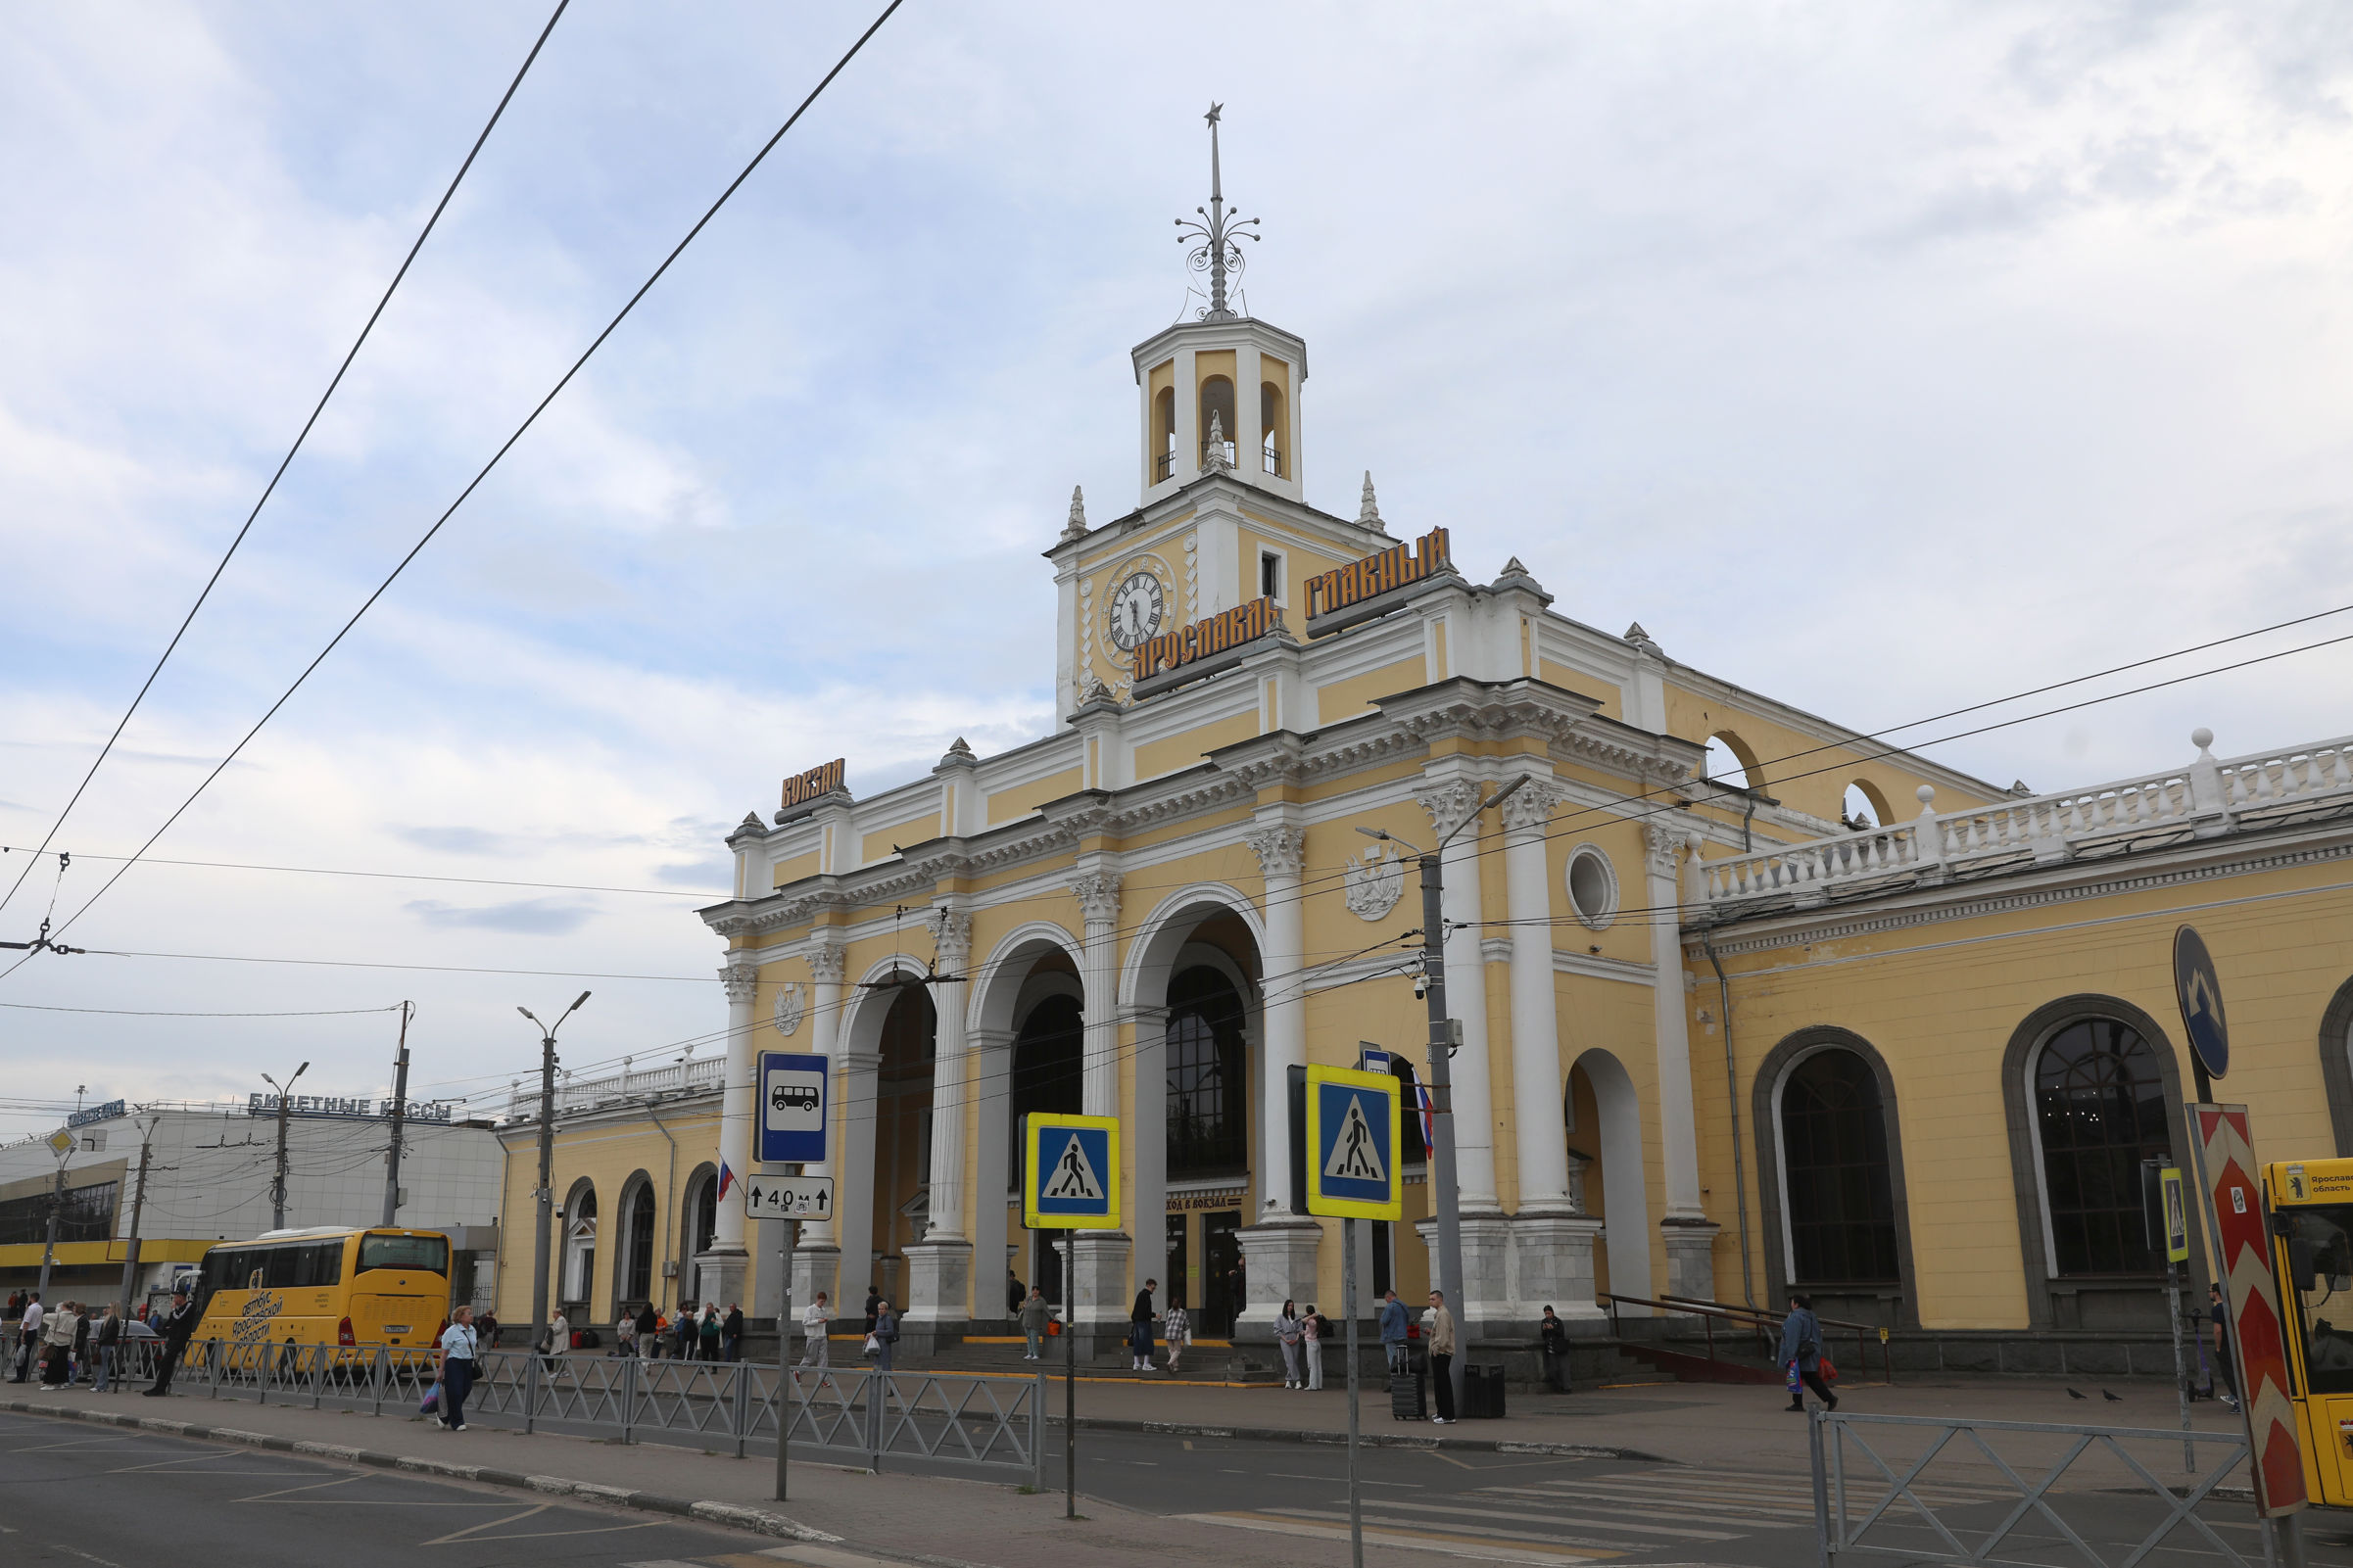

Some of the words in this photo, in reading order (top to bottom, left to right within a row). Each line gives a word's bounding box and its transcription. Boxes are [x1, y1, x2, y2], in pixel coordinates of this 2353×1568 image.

[1133, 595, 1282, 682] ЯРОСЛАВЛЬ
[1304, 526, 1451, 620] ГЛАВНЫЙ
[782, 758, 845, 809] ВОКЗАЛ
[380, 1100, 451, 1118] КССЫ
[768, 1190, 793, 1206] 40
[1166, 1199, 1182, 1211] ХОД
[1185, 1199, 1191, 1209] В
[1192, 1197, 1226, 1209] ВОКЗАЛ
